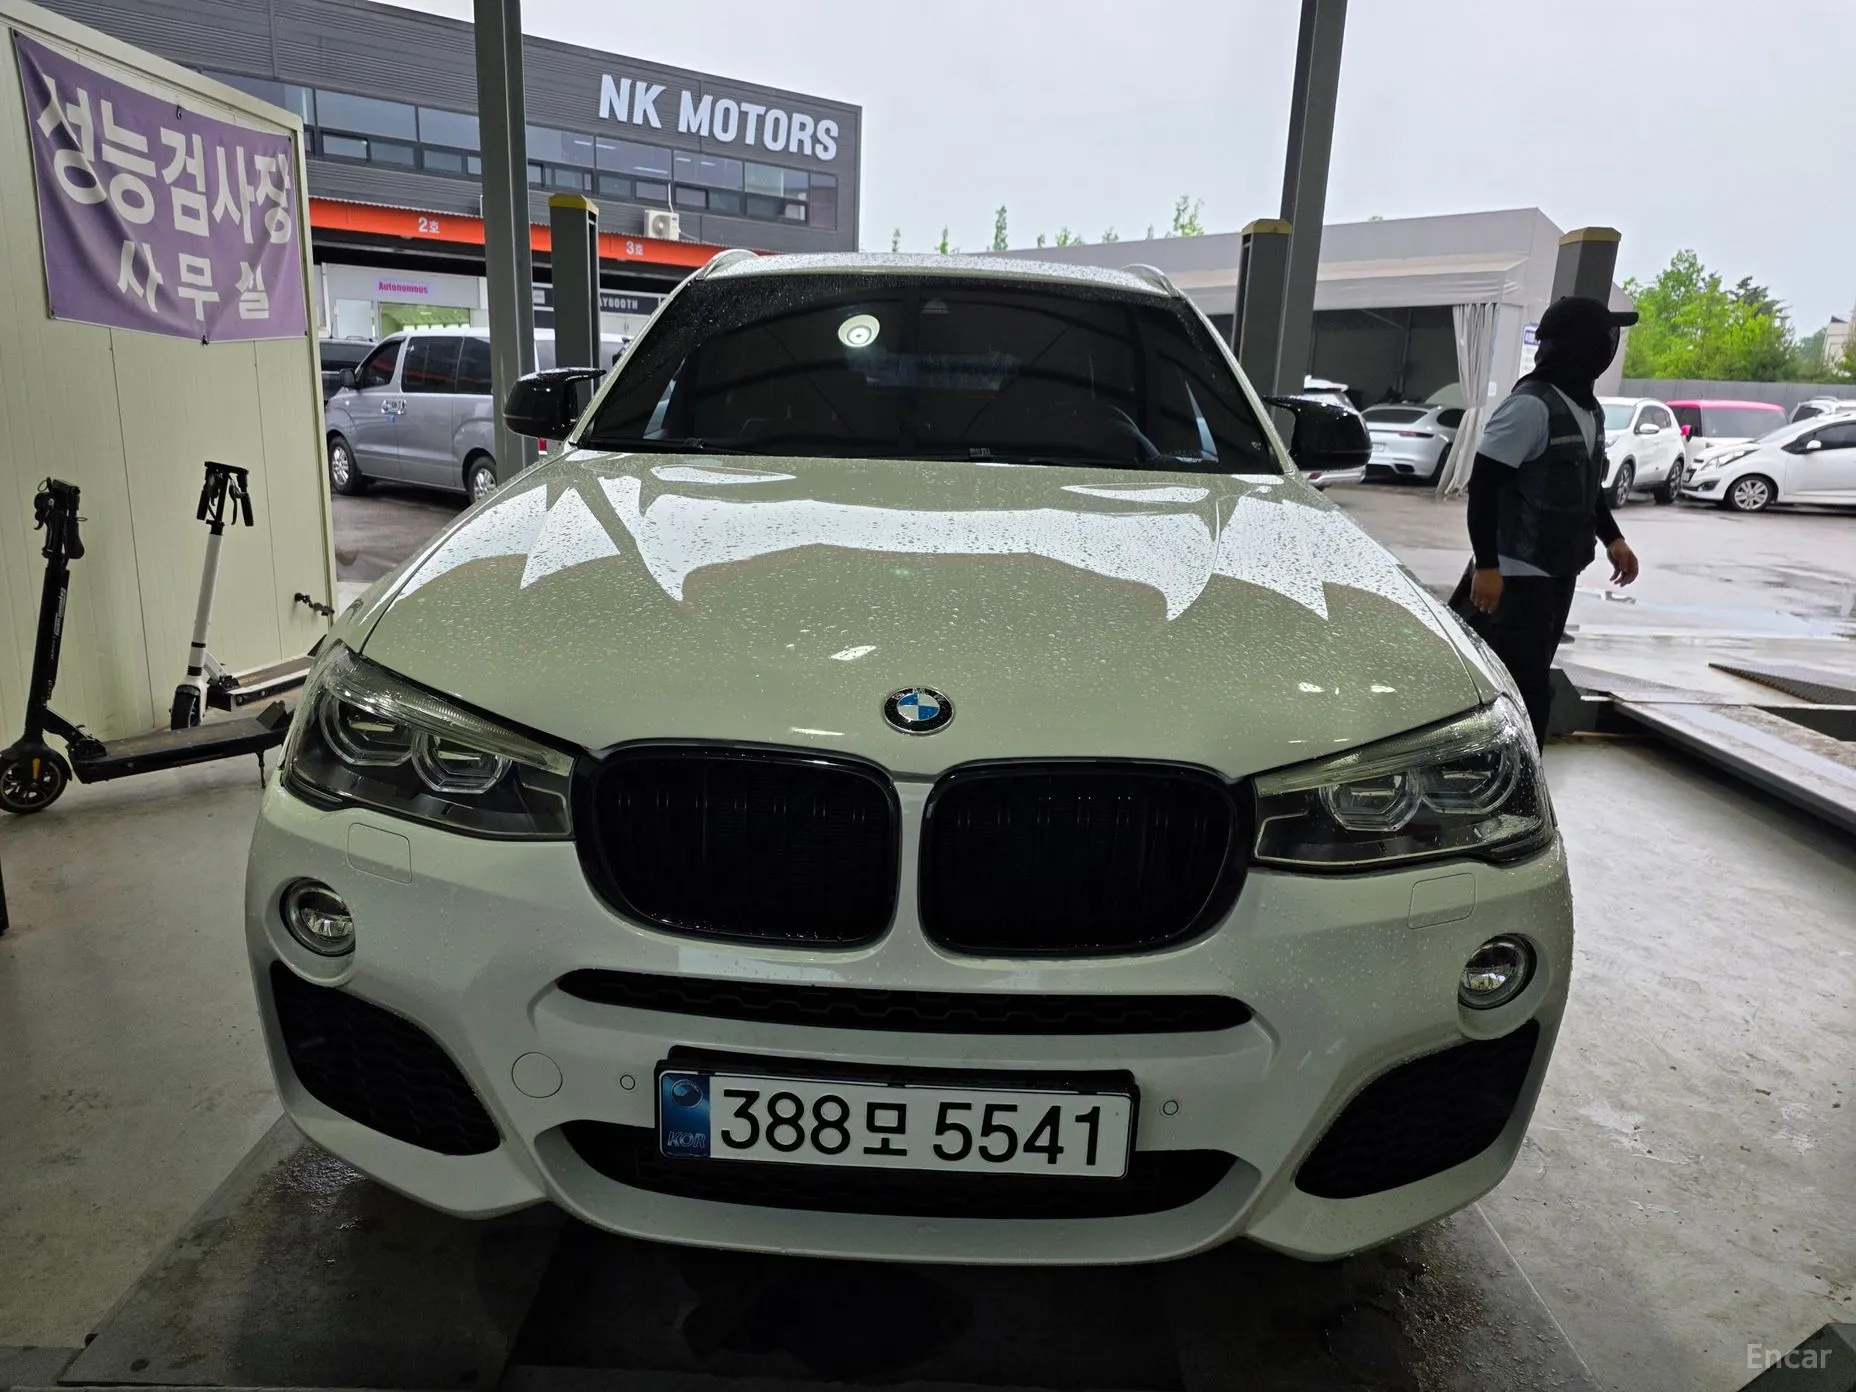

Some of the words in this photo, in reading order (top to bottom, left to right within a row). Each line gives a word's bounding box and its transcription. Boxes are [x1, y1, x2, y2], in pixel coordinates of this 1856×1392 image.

[599, 74, 667, 129] NK
[678, 90, 838, 161] MOTORS
[36, 73, 292, 244] 성능검사장
[418, 216, 440, 234] 2호
[626, 240, 644, 256] 3호
[378, 281, 428, 294] Autonomous
[667, 1131, 706, 1149] KOR
[933, 1101, 1101, 1165] 5541
